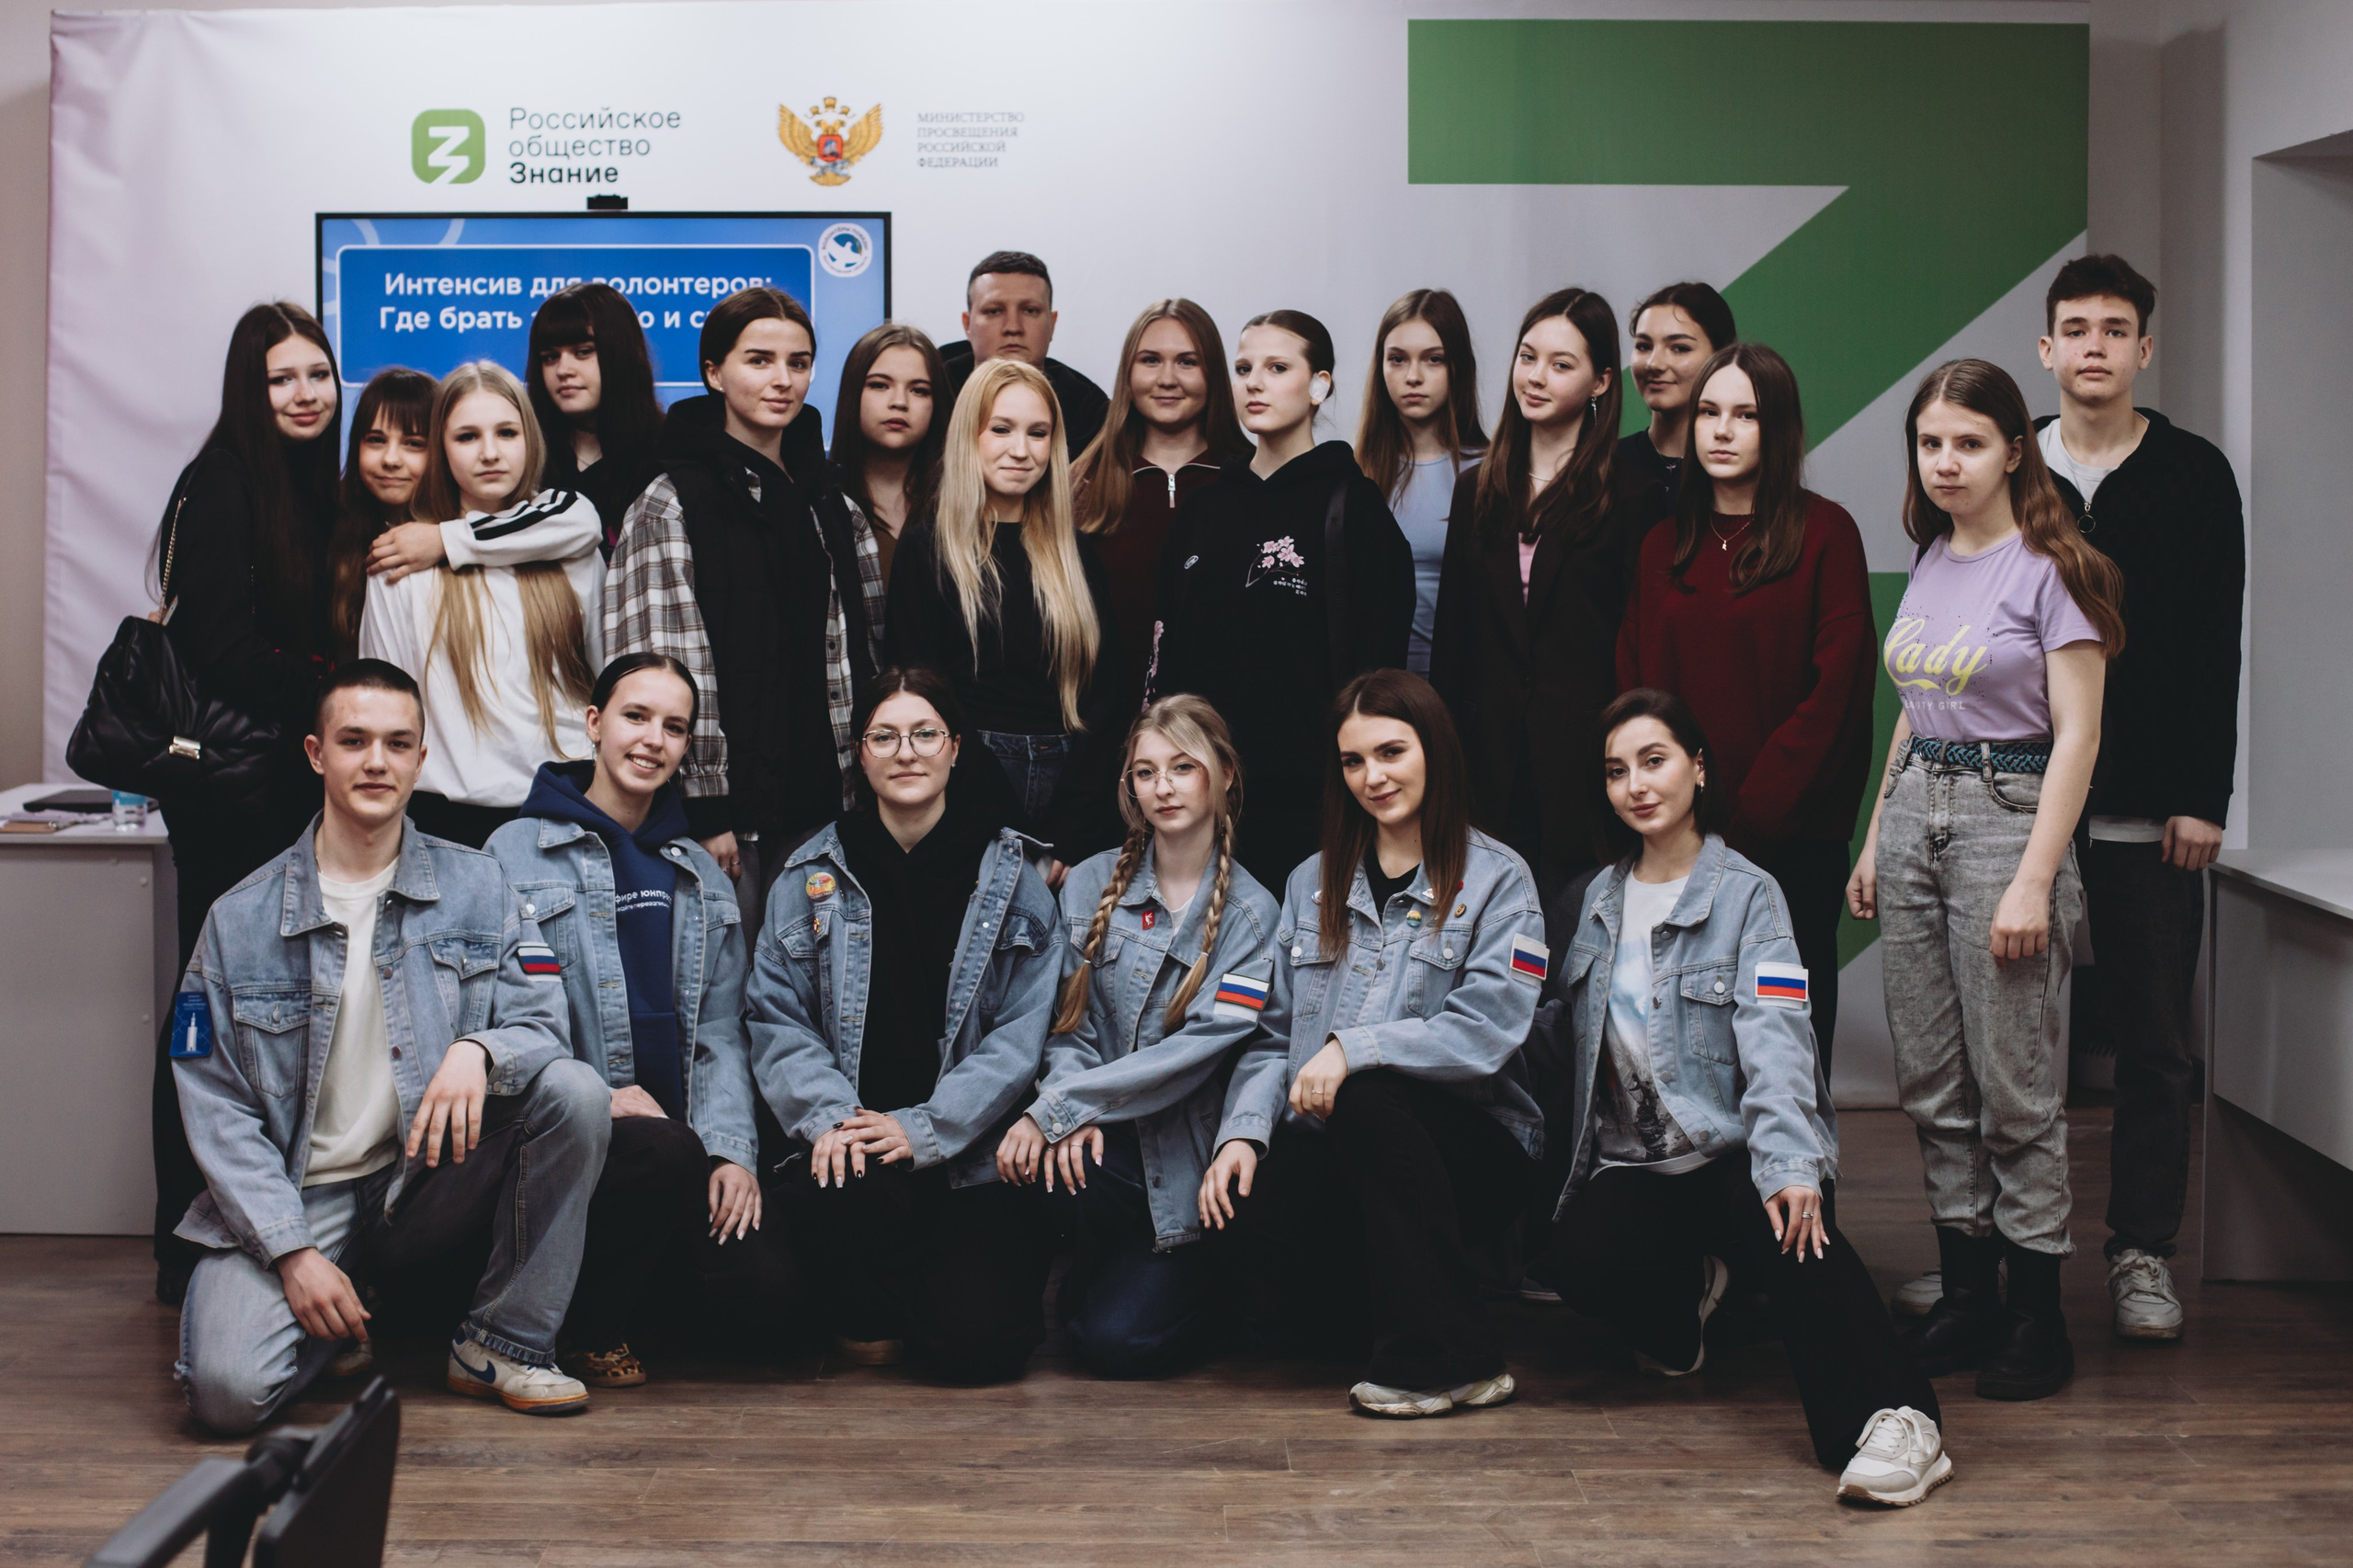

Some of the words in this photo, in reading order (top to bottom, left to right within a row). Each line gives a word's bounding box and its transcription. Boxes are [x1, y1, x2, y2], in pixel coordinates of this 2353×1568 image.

[510, 107, 681, 130] Российское
[917, 112, 1025, 123] МИНИСТЕРСТВО
[917, 127, 1017, 138] ПРОСВЕЩЕНИЯ
[509, 135, 651, 160] общество
[917, 141, 1006, 153] РОССИЙСКОЙ
[917, 157, 998, 168] ФЕДЕРАЦИИ
[509, 162, 619, 183] Знание
[385, 273, 523, 296] Интенсив
[380, 306, 431, 333] Где
[438, 306, 523, 334] брать
[664, 311, 681, 328] и
[1938, 700, 1966, 711] GIRL
[615, 892, 638, 903] фире
